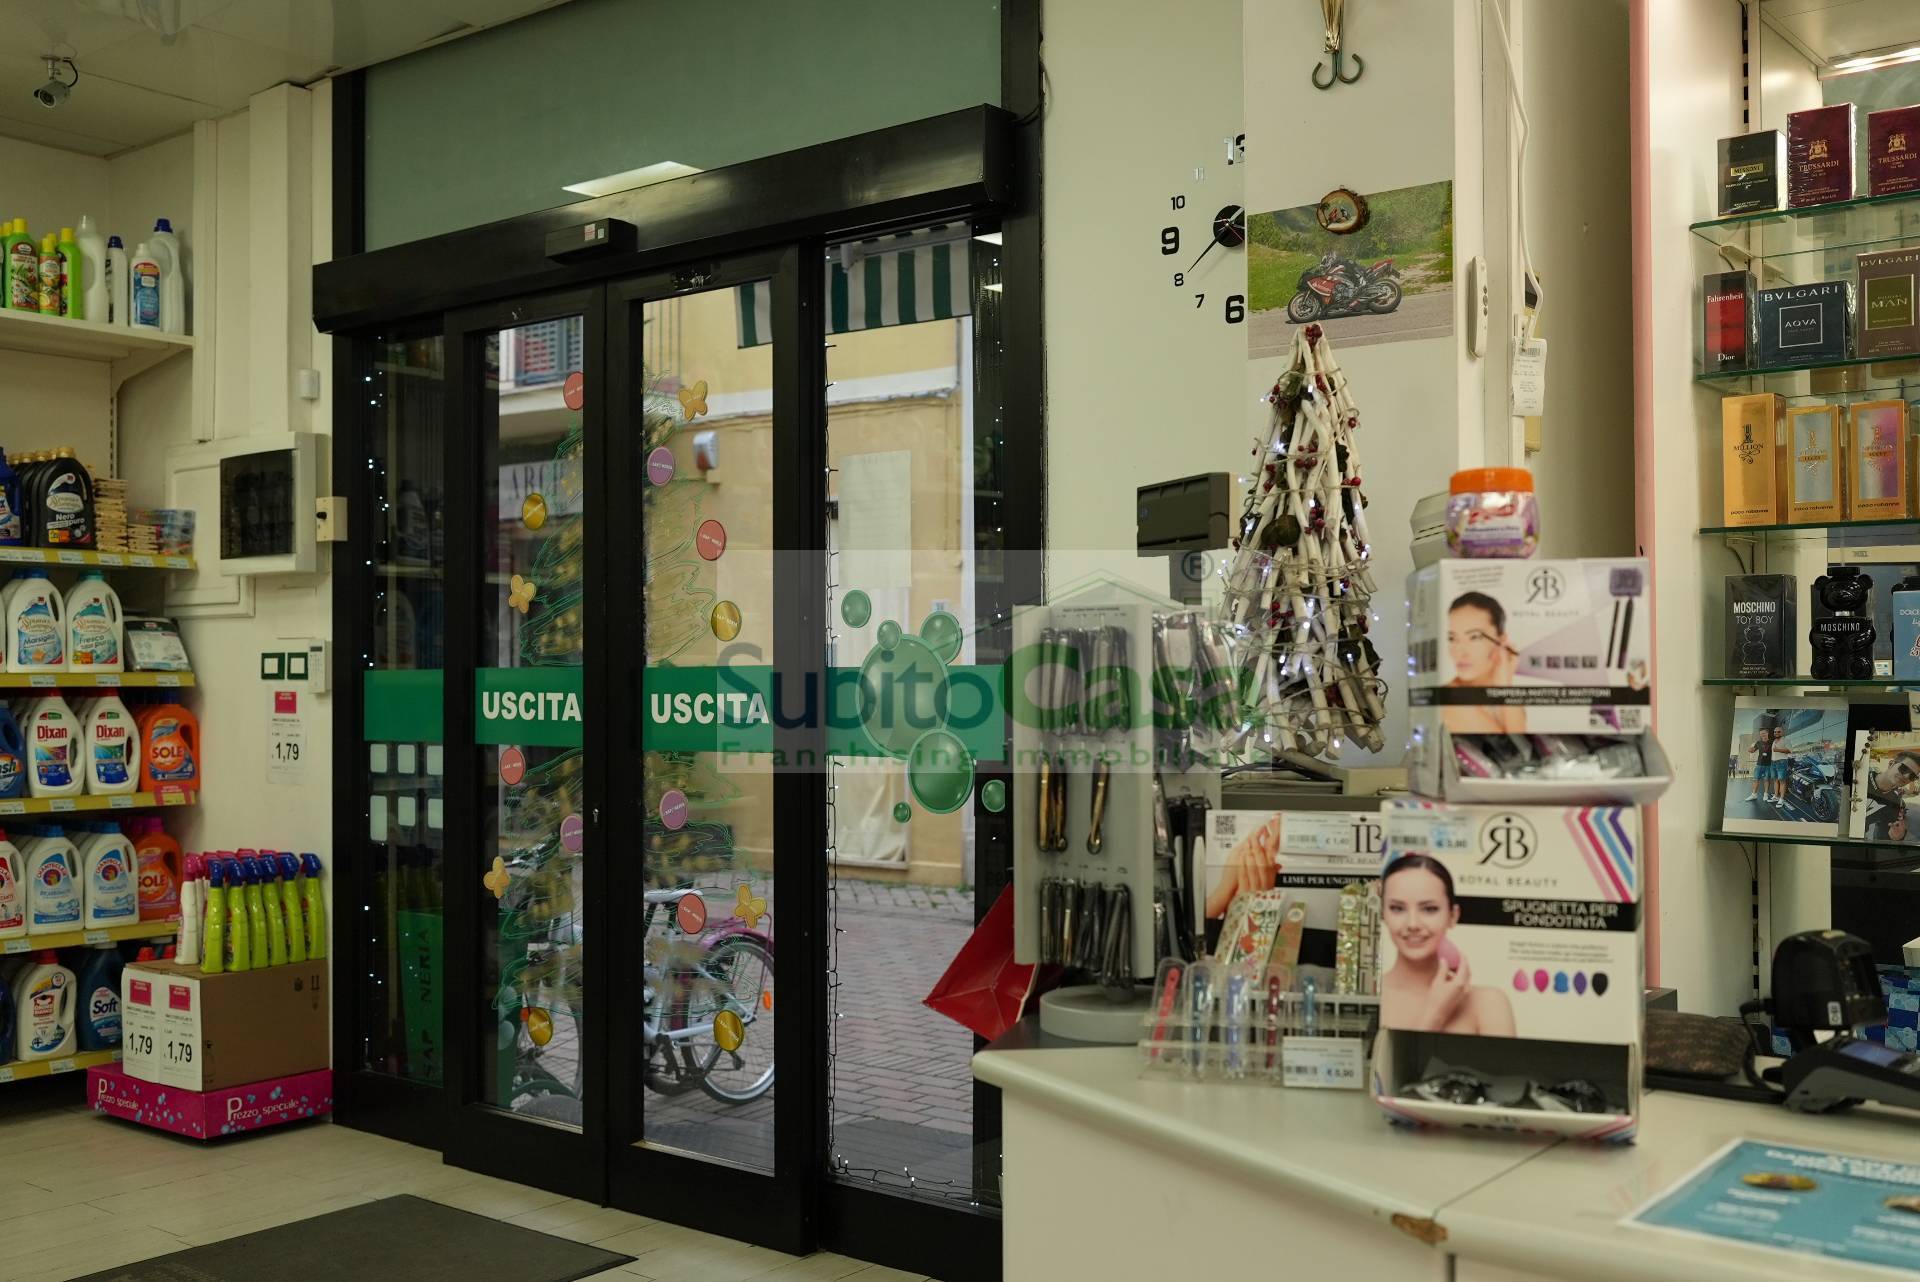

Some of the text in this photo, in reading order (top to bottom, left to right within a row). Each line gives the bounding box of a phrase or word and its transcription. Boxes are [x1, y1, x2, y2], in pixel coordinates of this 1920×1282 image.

[1878, 153, 1918, 164] TRUSSARDI
[1799, 160, 1840, 172] TRUSSARDI
[1170, 195, 1185, 210] 10
[1161, 226, 1180, 255] 9
[1860, 254, 1920, 267] BVLGARI
[1174, 272, 1184, 287] 8
[1707, 292, 1744, 303] Fahrenheit
[1764, 285, 1839, 302] BVLGARI
[1195, 294, 1205, 308] 7
[1871, 298, 1907, 309] MAN
[1225, 294, 1245, 324] 6
[1717, 352, 1736, 362] Dior
[1734, 442, 1763, 451] MILLION
[56, 513, 75, 521] Nero
[1733, 602, 1776, 614] MOSCHINO
[1736, 615, 1774, 625] TOY BOY
[1820, 623, 1860, 632] MOSCHINO
[482, 691, 582, 721] USCITA
[650, 693, 770, 724] USCITA
[37, 725, 68, 739] Dixan
[96, 725, 125, 738] Dixan
[152, 746, 184, 760] SOLE
[275, 742, 299, 762] 1,79
[1307, 876, 1325, 884] PER
[1459, 875, 1558, 888] ROYAL BEAUTY
[1502, 899, 1618, 917] SPUGNETTA PER
[1513, 912, 1608, 929] FONDOTINTA
[92, 998, 119, 1015] Soft
[129, 1032, 153, 1055] 1,79
[167, 1041, 193, 1063] 1,79
[98, 1078, 139, 1112] Prezzo speciale
[227, 1096, 300, 1121] Prezzo speciale
